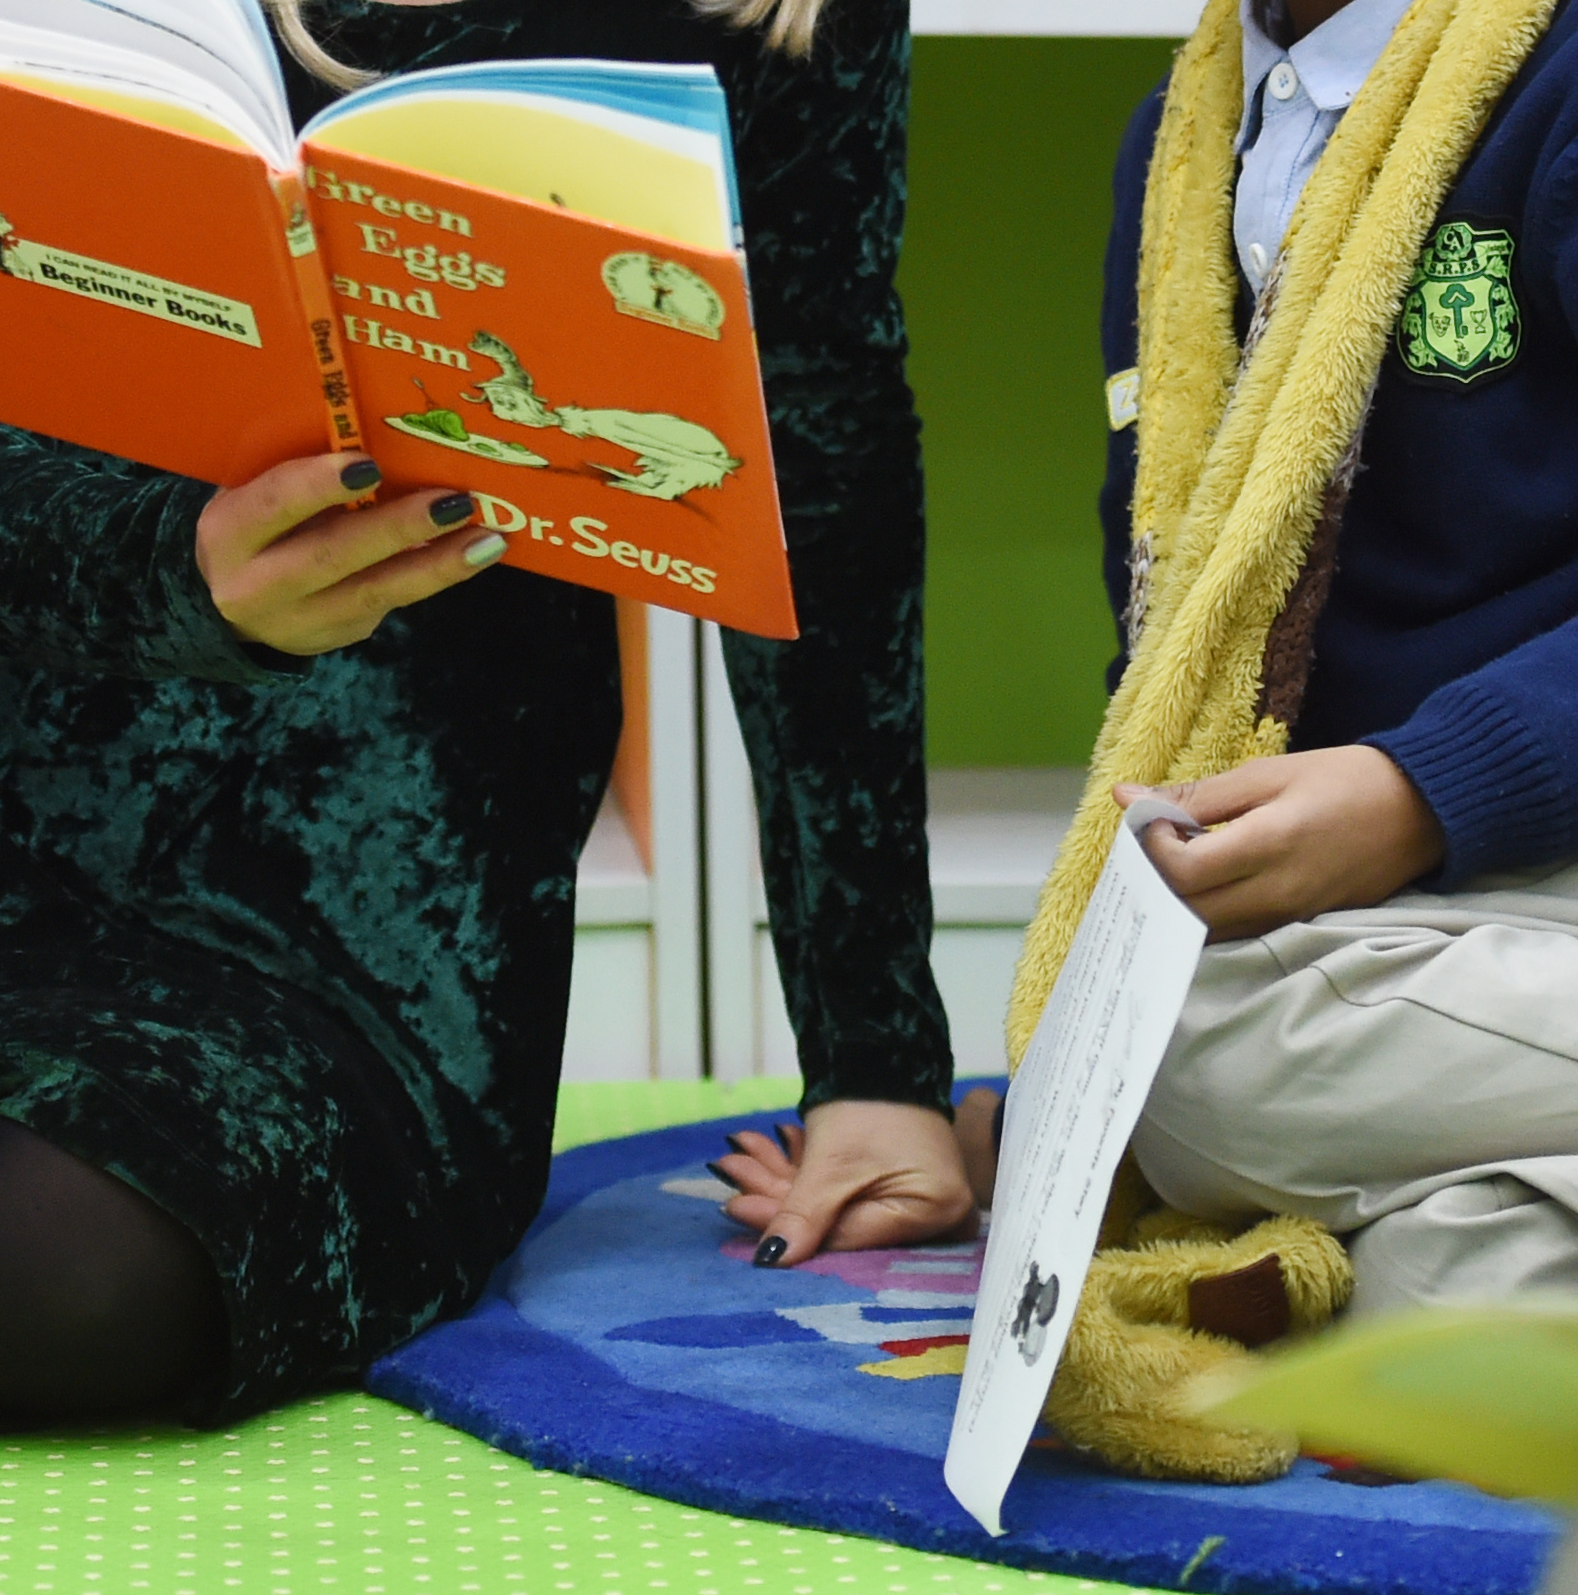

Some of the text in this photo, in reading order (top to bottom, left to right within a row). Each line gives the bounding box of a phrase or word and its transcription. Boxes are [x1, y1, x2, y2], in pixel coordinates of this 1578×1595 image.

[307, 165, 474, 238] Green
[356, 222, 506, 291] Eggs
[40, 262, 247, 336] Beginner Books
[333, 274, 441, 319] and
[343, 315, 472, 372] Ham
[470, 491, 717, 594] Dr. Seuss
